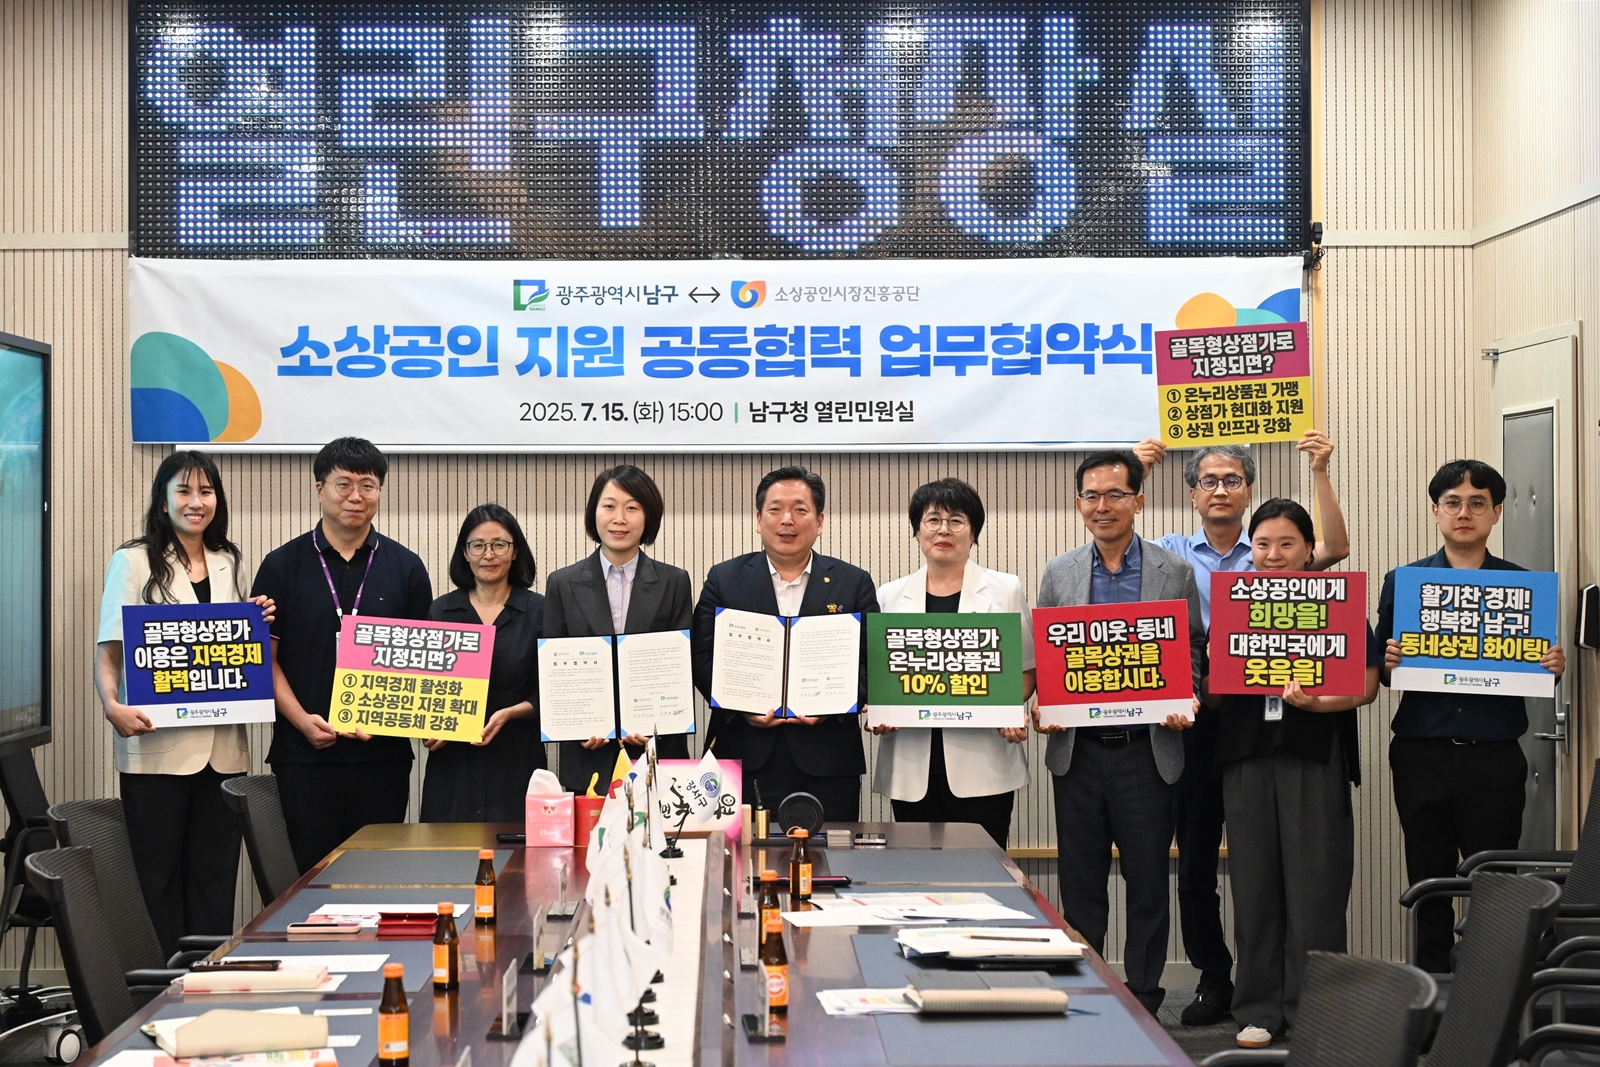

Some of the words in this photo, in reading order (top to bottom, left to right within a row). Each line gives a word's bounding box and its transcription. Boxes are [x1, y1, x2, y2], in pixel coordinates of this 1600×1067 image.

[774, 285, 920, 303] 소상공인시장진흥공단
[277, 324, 500, 379] 소상공인
[514, 325, 625, 378] 지원
[640, 323, 862, 379] 공동협력
[878, 322, 1153, 378] 업무협약식
[1169, 330, 1295, 358] 골목형상점가로
[1192, 354, 1274, 378] 지정되면?
[1184, 383, 1268, 403] 온누리상품권
[1271, 380, 1300, 398] 가맹
[519, 402, 577, 422] 2025.
[632, 400, 664, 424] (화)
[668, 402, 724, 422] 15:00
[748, 400, 809, 424] 남구청
[814, 400, 915, 423] 열린민원실
[1185, 403, 1228, 421] 상점가
[1230, 400, 1273, 418] 현대화
[1276, 398, 1305, 415] 지원
[1186, 422, 1215, 439] 상권
[1217, 419, 1260, 437] 인프라
[1262, 417, 1292, 434] 강화
[1230, 578, 1346, 600] 소상공인에게
[1421, 584, 1482, 609] 활기찬
[1484, 587, 1532, 611] 경제!
[1249, 601, 1327, 629] 희망을!
[1420, 609, 1481, 633] 행복한
[1484, 612, 1530, 636] 남구!
[143, 619, 251, 645] 골목형상점가
[355, 624, 480, 651] 골목형상점가로
[886, 628, 999, 649] 골목형상점가
[1048, 622, 1086, 646] 우리
[134, 645, 189, 669] 이용은
[191, 642, 263, 666] 지역경제
[1065, 642, 1160, 669] 골목상권을
[1229, 633, 1346, 657] 대한민국에게
[1401, 633, 1478, 659] 동네상권
[1483, 636, 1550, 662] 화이팅!
[373, 646, 456, 671] 지정되면?
[888, 651, 1001, 672] 온누리상품권
[152, 667, 248, 694] 활력입니다.
[1064, 667, 1165, 692] 이용합시다.
[1245, 658, 1323, 686] 웃음을!
[360, 674, 417, 693] 지역경제
[419, 678, 463, 697] 활성화
[900, 674, 946, 694] 10%
[949, 674, 988, 695] 할인
[357, 692, 414, 711] 소상공인
[417, 696, 446, 714] 지원
[449, 698, 478, 715] 확대
[355, 710, 426, 730] 지역공동체
[429, 715, 459, 732] 강화
